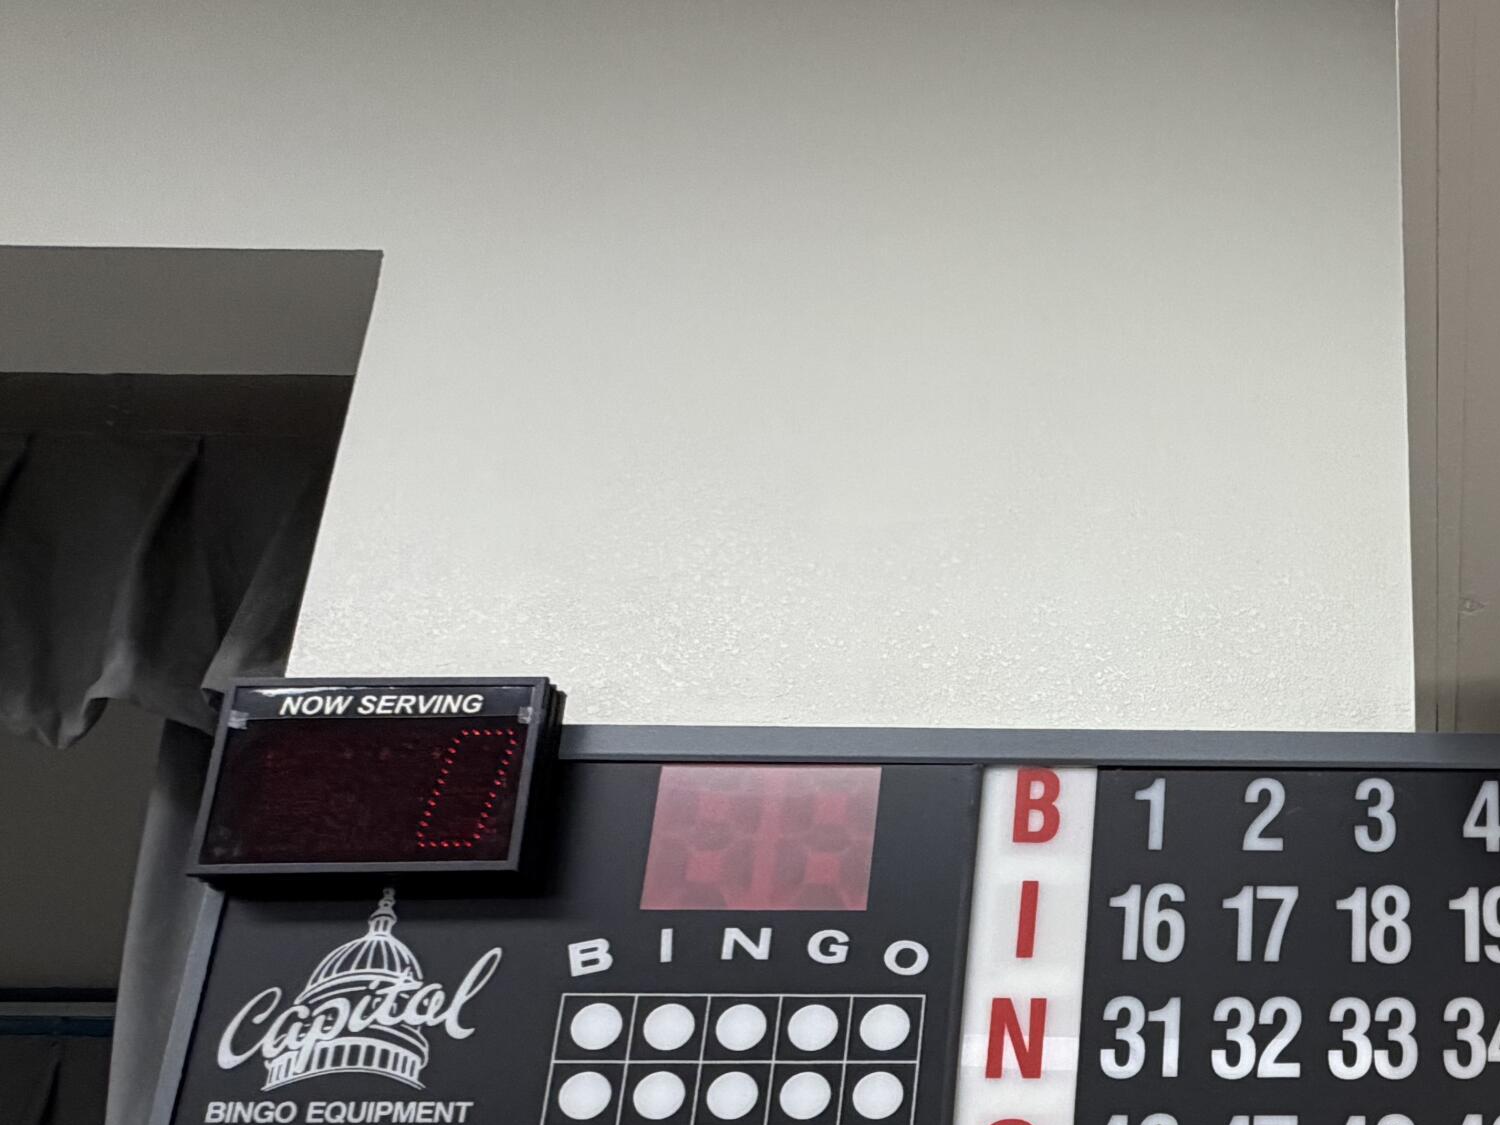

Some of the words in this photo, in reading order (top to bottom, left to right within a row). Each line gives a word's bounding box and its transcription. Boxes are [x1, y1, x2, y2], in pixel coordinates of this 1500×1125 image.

[278, 695, 354, 716] NOW
[357, 693, 485, 715] SERVING
[1134, 778, 1166, 851] 1
[1242, 777, 1286, 852] 2
[1354, 777, 1397, 853] 3
[1109, 883, 1186, 963] 16
[1222, 885, 1299, 962] 17
[1336, 884, 1412, 965] 18
[217, 946, 503, 1075] Capital
[1099, 995, 1181, 1080] 31
[1210, 996, 1302, 1080] 32
[1327, 996, 1419, 1081] 33
[204, 1101, 298, 1124] BINGO
[305, 1101, 474, 1124] EQUIPMENT
